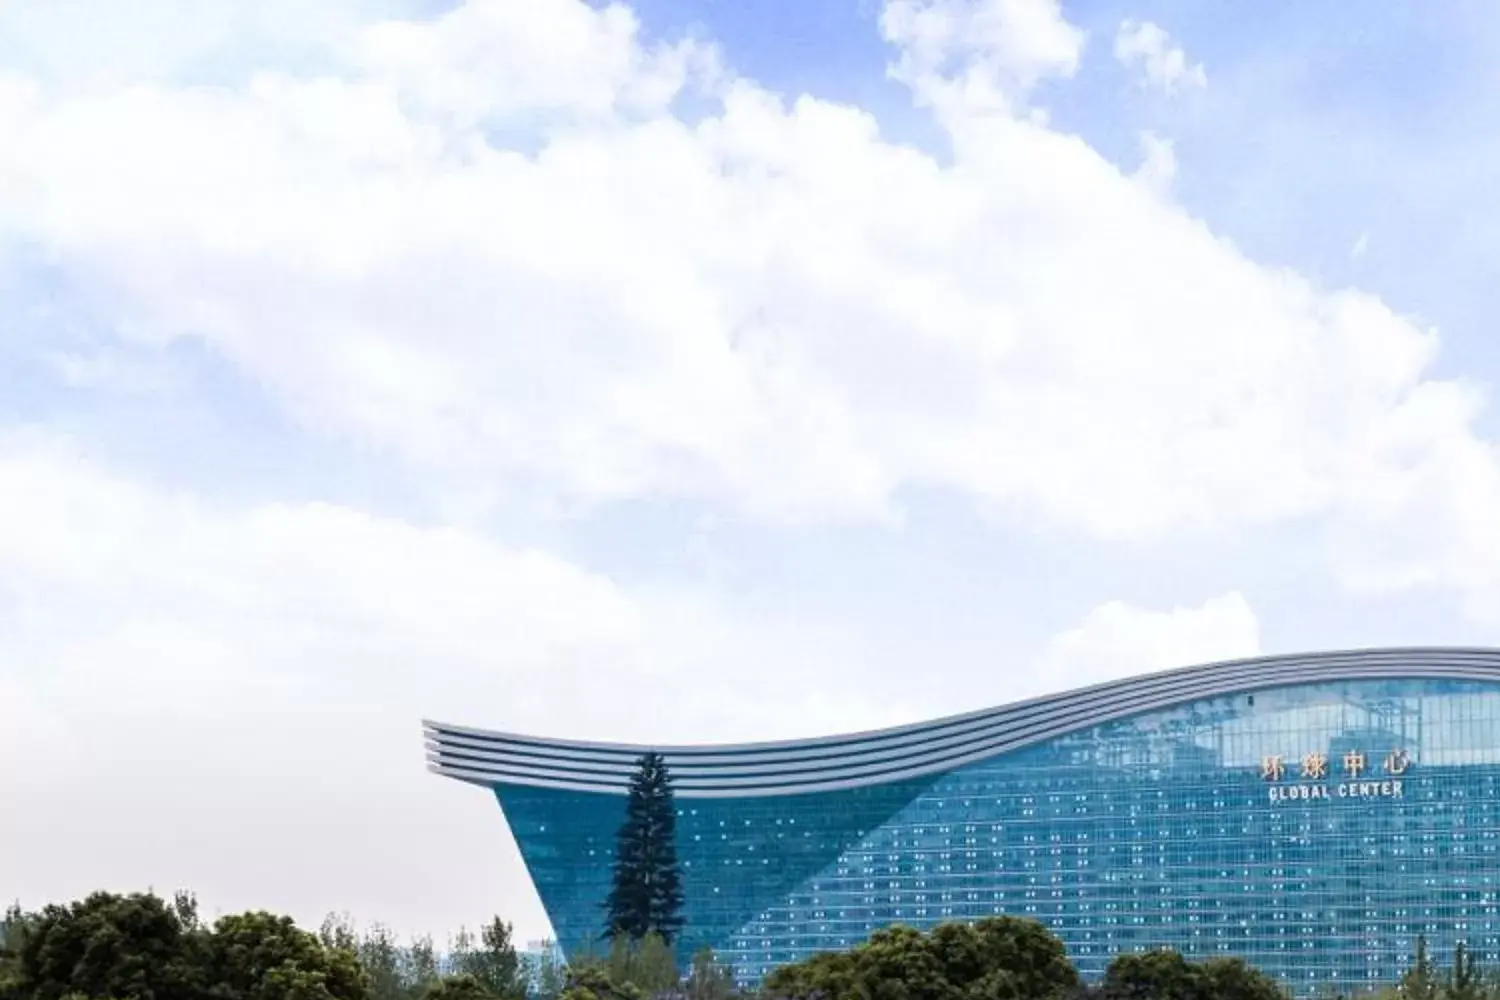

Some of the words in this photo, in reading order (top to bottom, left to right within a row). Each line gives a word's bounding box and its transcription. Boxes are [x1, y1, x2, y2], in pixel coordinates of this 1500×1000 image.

[1261, 749, 1411, 781] 环球中心
[1269, 784, 1330, 800] GLOBAL
[1339, 780, 1403, 798] CENTER
